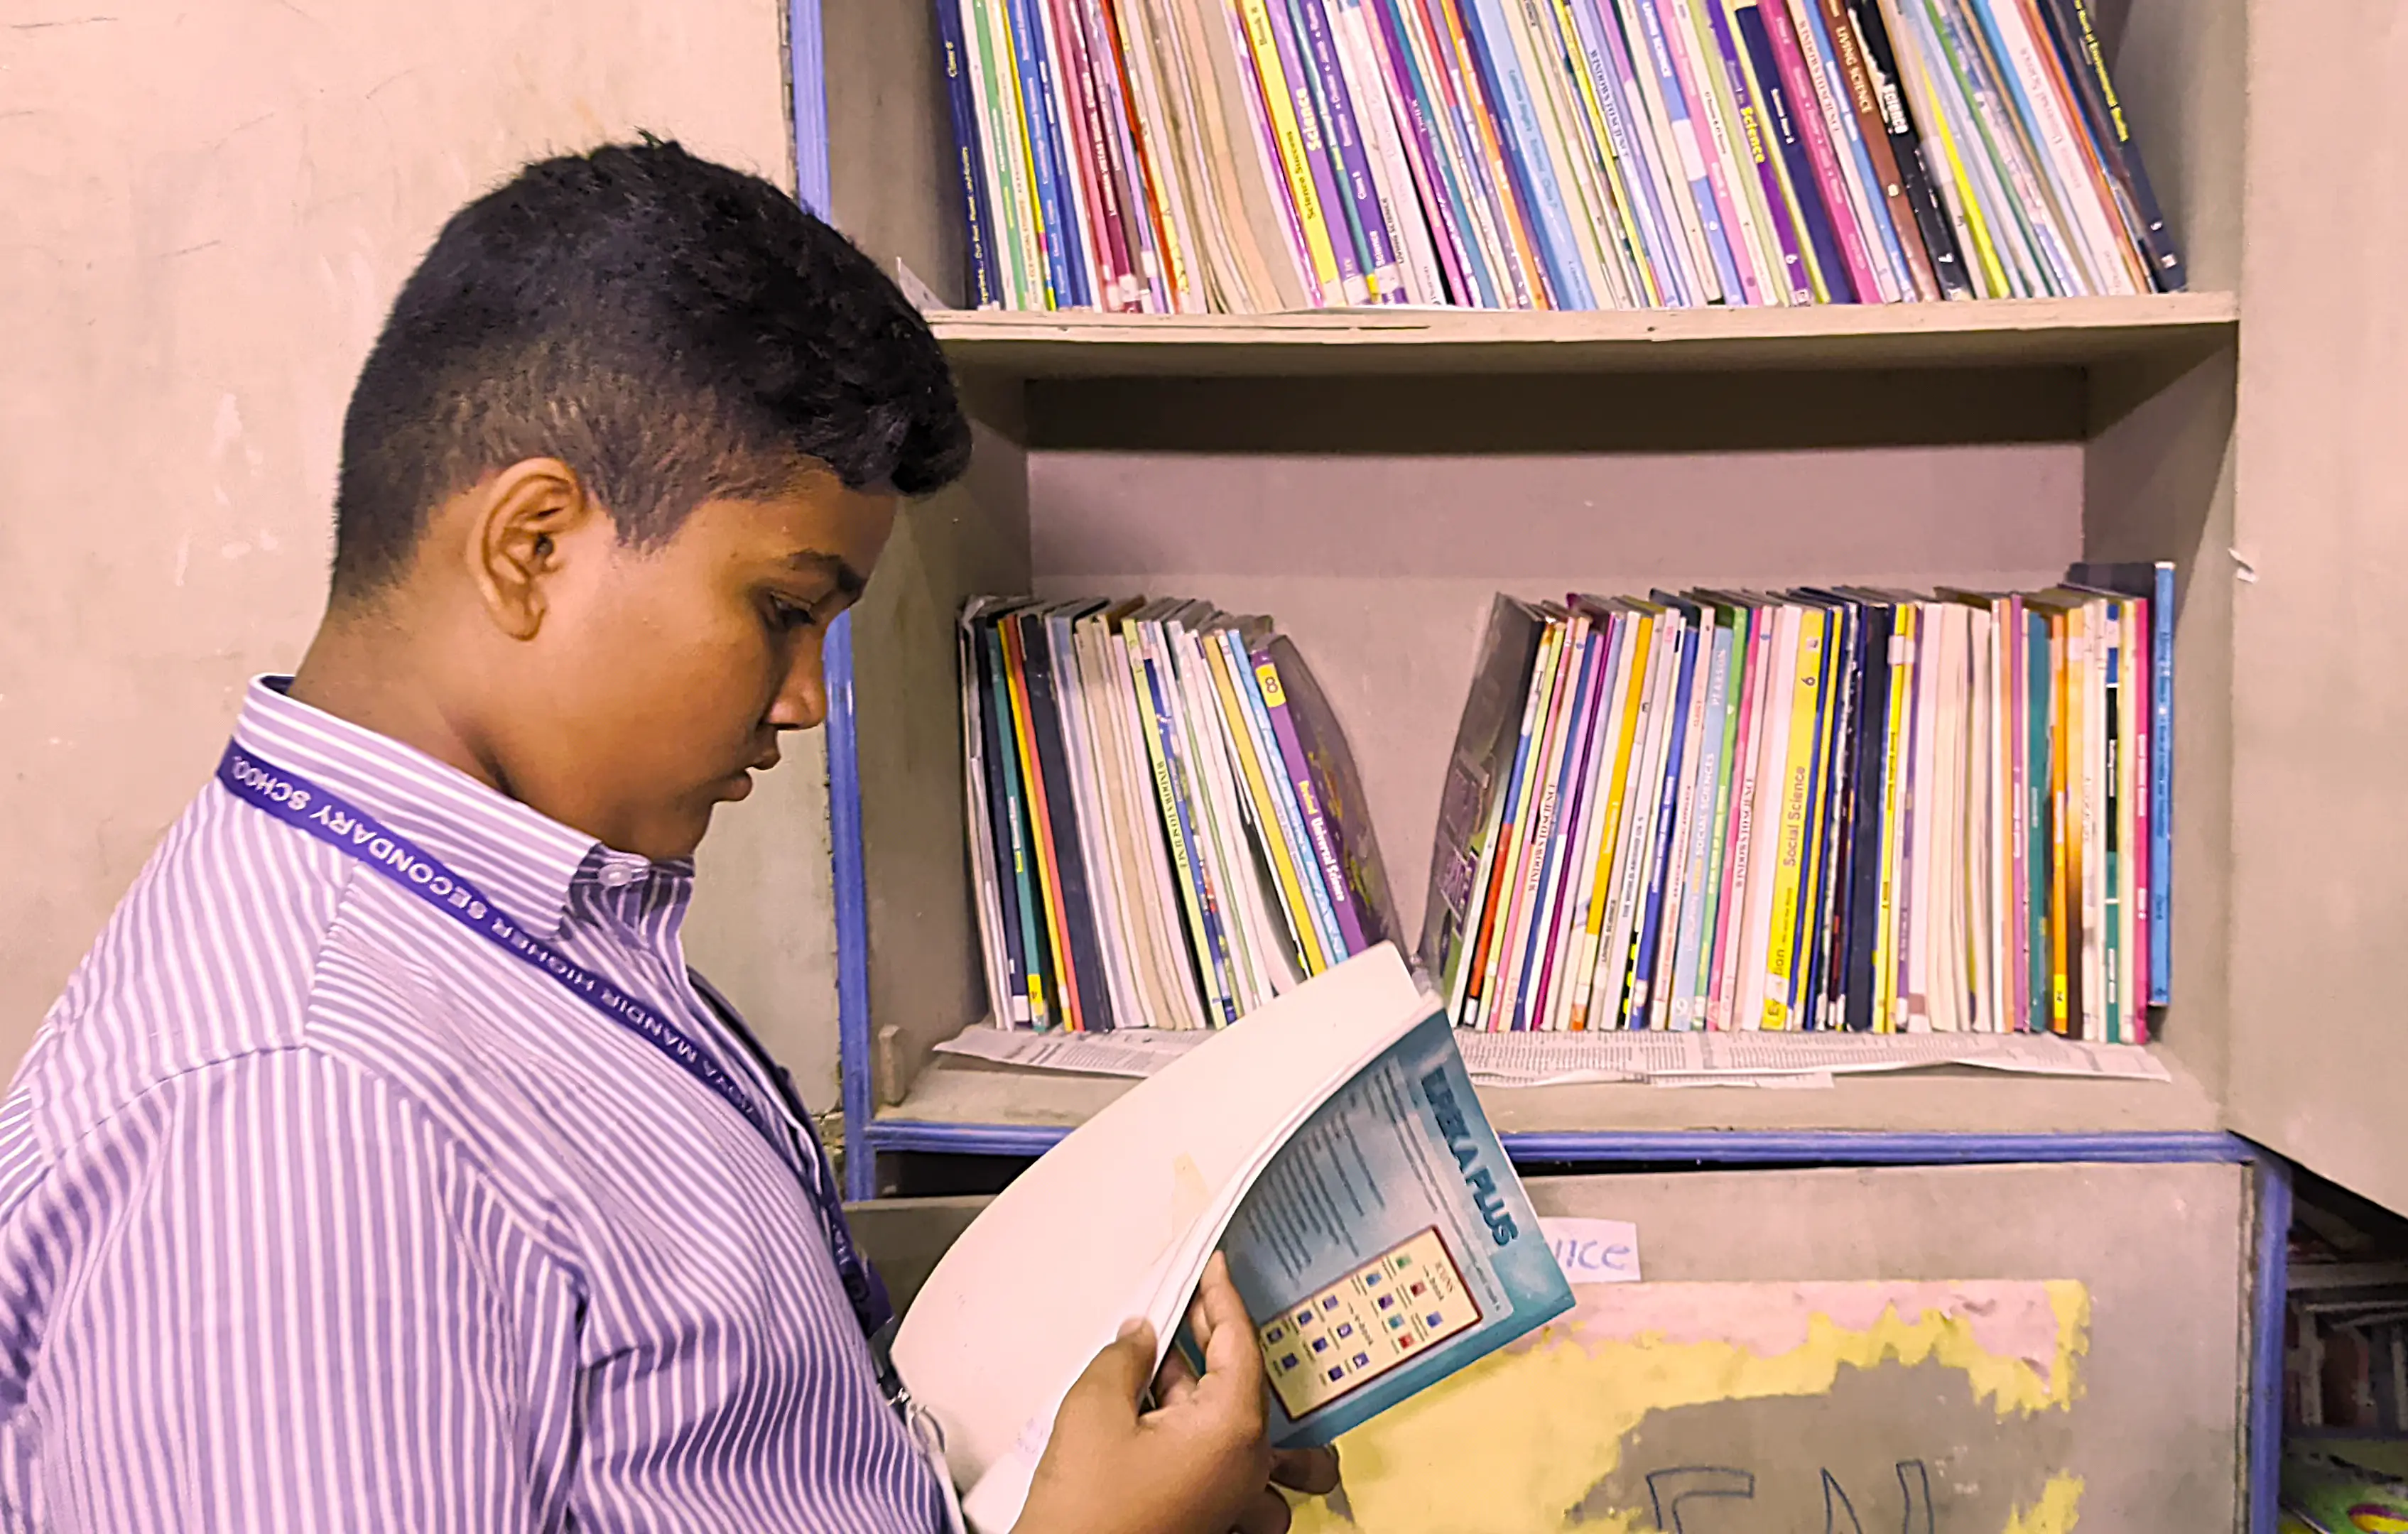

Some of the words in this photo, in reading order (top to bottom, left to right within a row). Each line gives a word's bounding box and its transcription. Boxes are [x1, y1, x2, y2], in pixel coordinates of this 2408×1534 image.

[1833, 24, 1857, 66] LIVING
[1846, 65, 1873, 115] SCIENCE
[1295, 86, 1323, 151] Science
[1740, 106, 1765, 164] Science
[1298, 175, 1316, 219] Science
[1709, 648, 1728, 706] PEARSON
[1799, 675, 1816, 687] 6
[1698, 752, 1715, 809] SCIENCES
[1787, 764, 1806, 822] Science
[308, 803, 489, 921] SECONDARY
[1310, 816, 1335, 866] Universal
[1325, 864, 1347, 903] Science
[1693, 813, 1707, 856] SOCIAL
[1782, 823, 1801, 868] Social
[1529, 840, 1546, 892] WINDOWS
[491, 916, 595, 992] HIGHER
[600, 989, 698, 1064] MANDIR
[1465, 1163, 1519, 1248] PLUS
